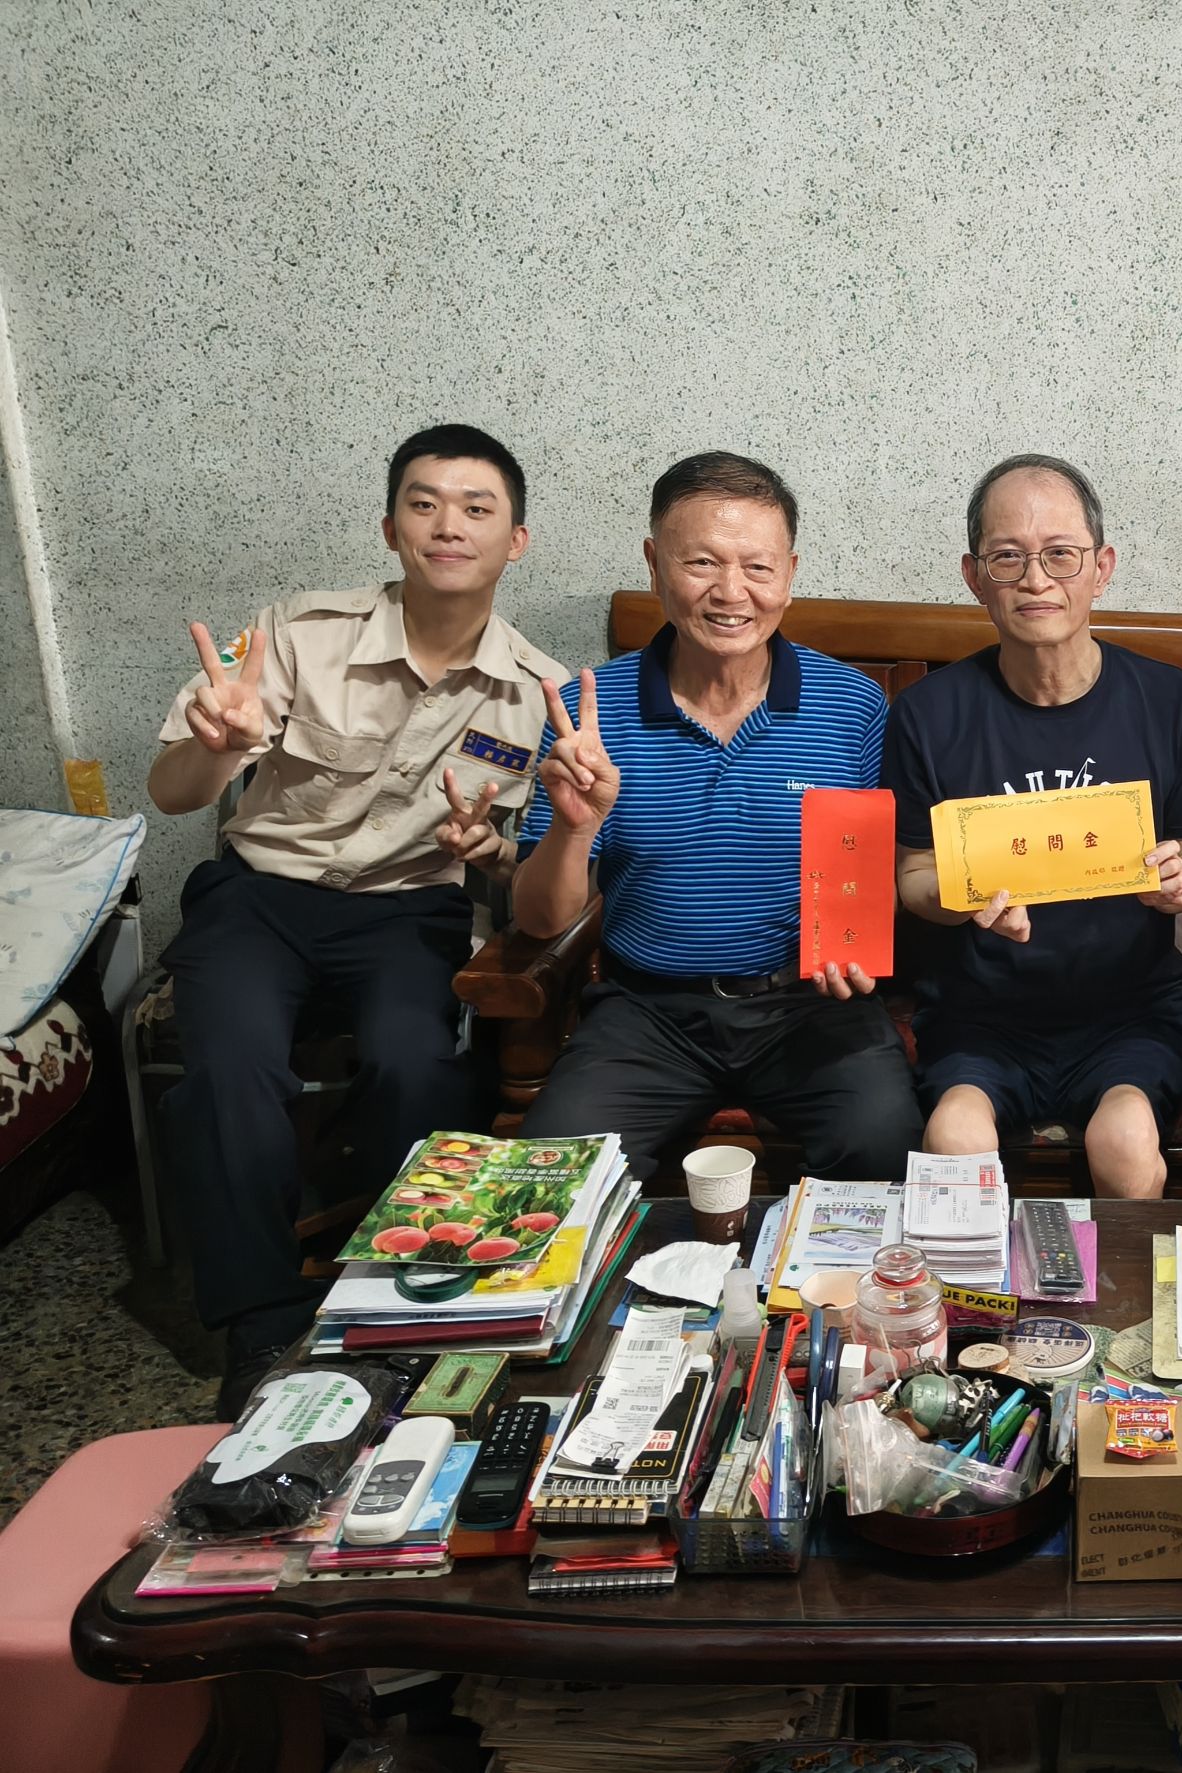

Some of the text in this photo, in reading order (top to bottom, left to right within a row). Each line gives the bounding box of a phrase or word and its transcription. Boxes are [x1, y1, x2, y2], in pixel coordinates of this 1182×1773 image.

[1011, 831, 1098, 856] 慰問金
[965, 1293, 1016, 1312] PACK!
[1118, 1412, 1168, 1423] 枇杷軟糖
[628, 1459, 666, 1468] NOT
[1089, 1510, 1155, 1521] CHANGHUA
[1090, 1523, 1157, 1535] CHANGHUA
